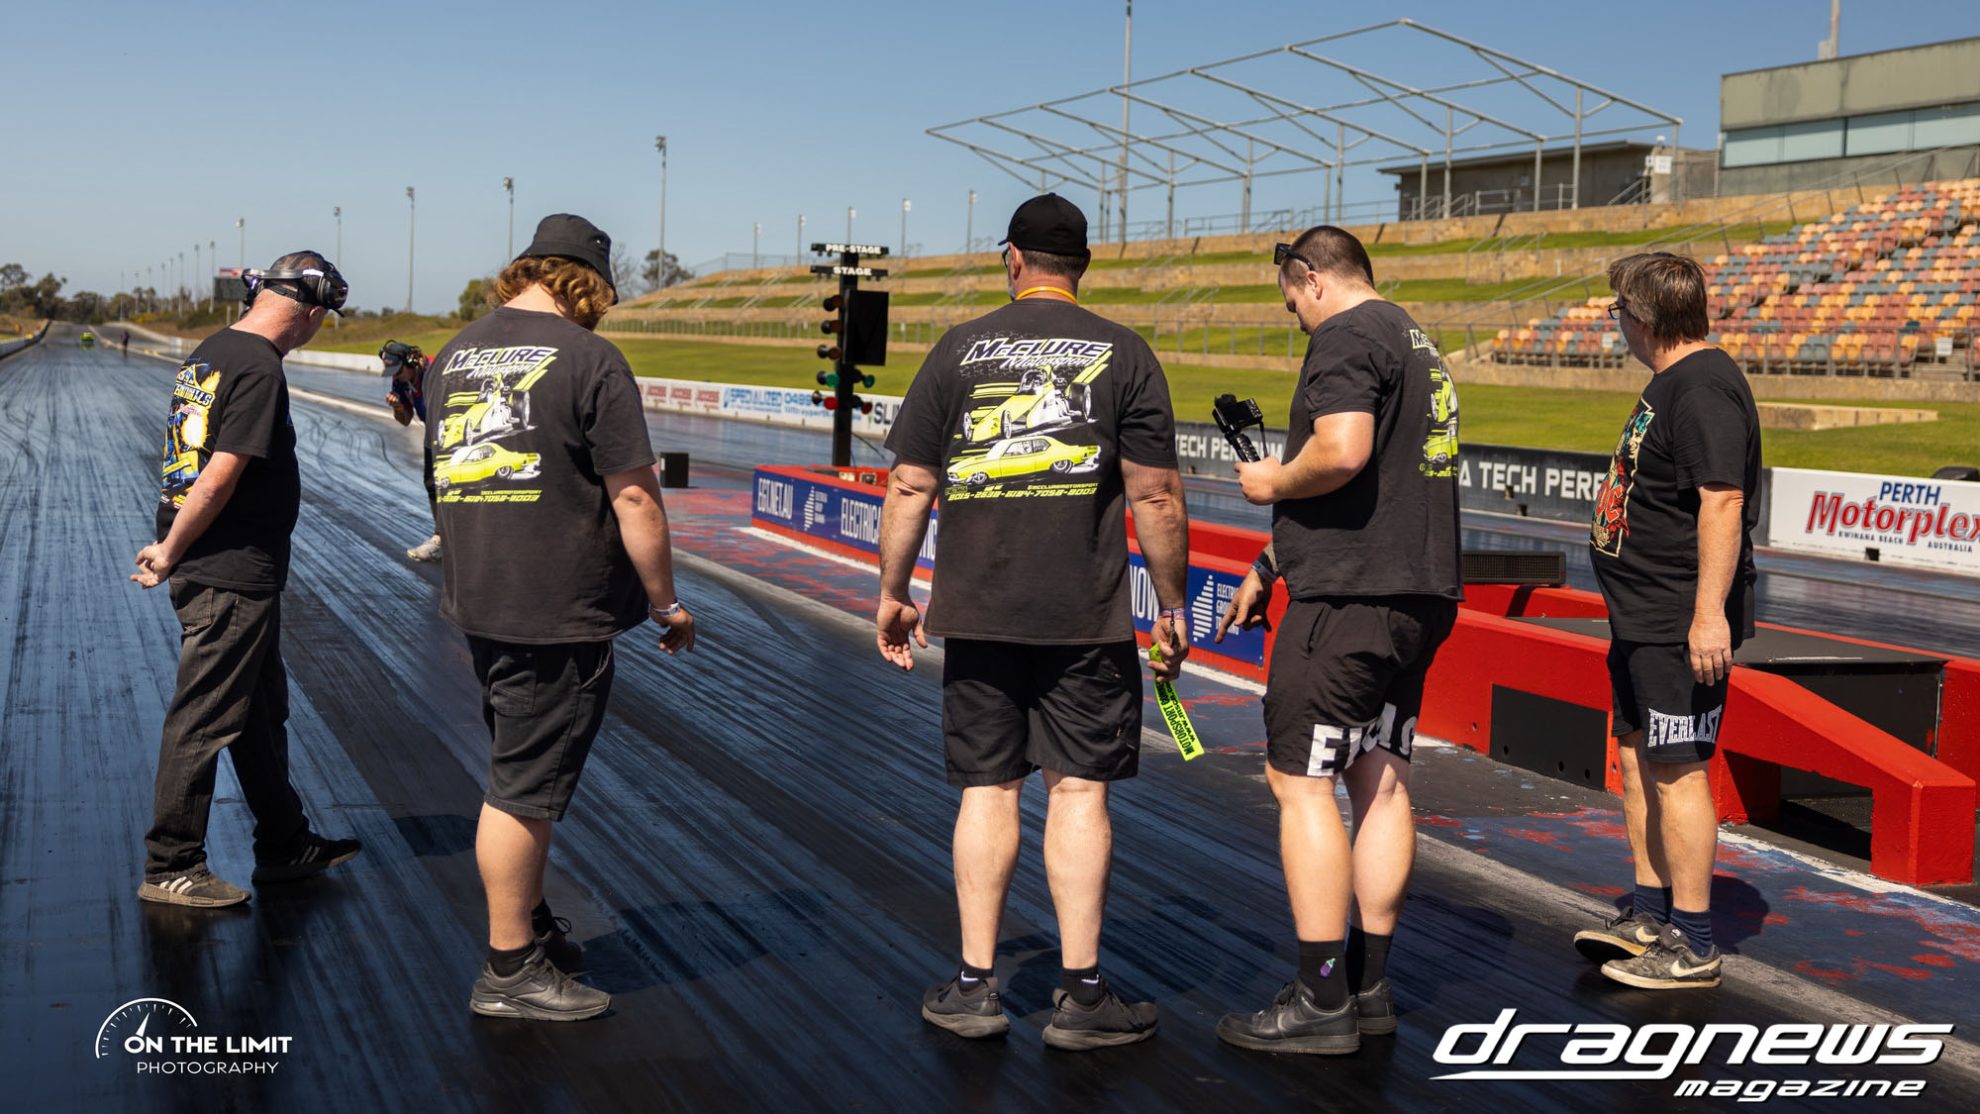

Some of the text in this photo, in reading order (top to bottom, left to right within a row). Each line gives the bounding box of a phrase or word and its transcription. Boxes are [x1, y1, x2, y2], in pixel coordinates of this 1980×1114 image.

[825, 243, 881, 255] PRE-STAGE
[833, 266, 872, 276] STAGE
[1479, 461, 1537, 495] TECH
[1879, 481, 1941, 505] PERTH
[1838, 530, 1973, 552] KWINANA BEACH AUSTRALIA
[1164, 705, 1195, 755] MOTORSPORT
[1648, 704, 1722, 747] EVERLAST
